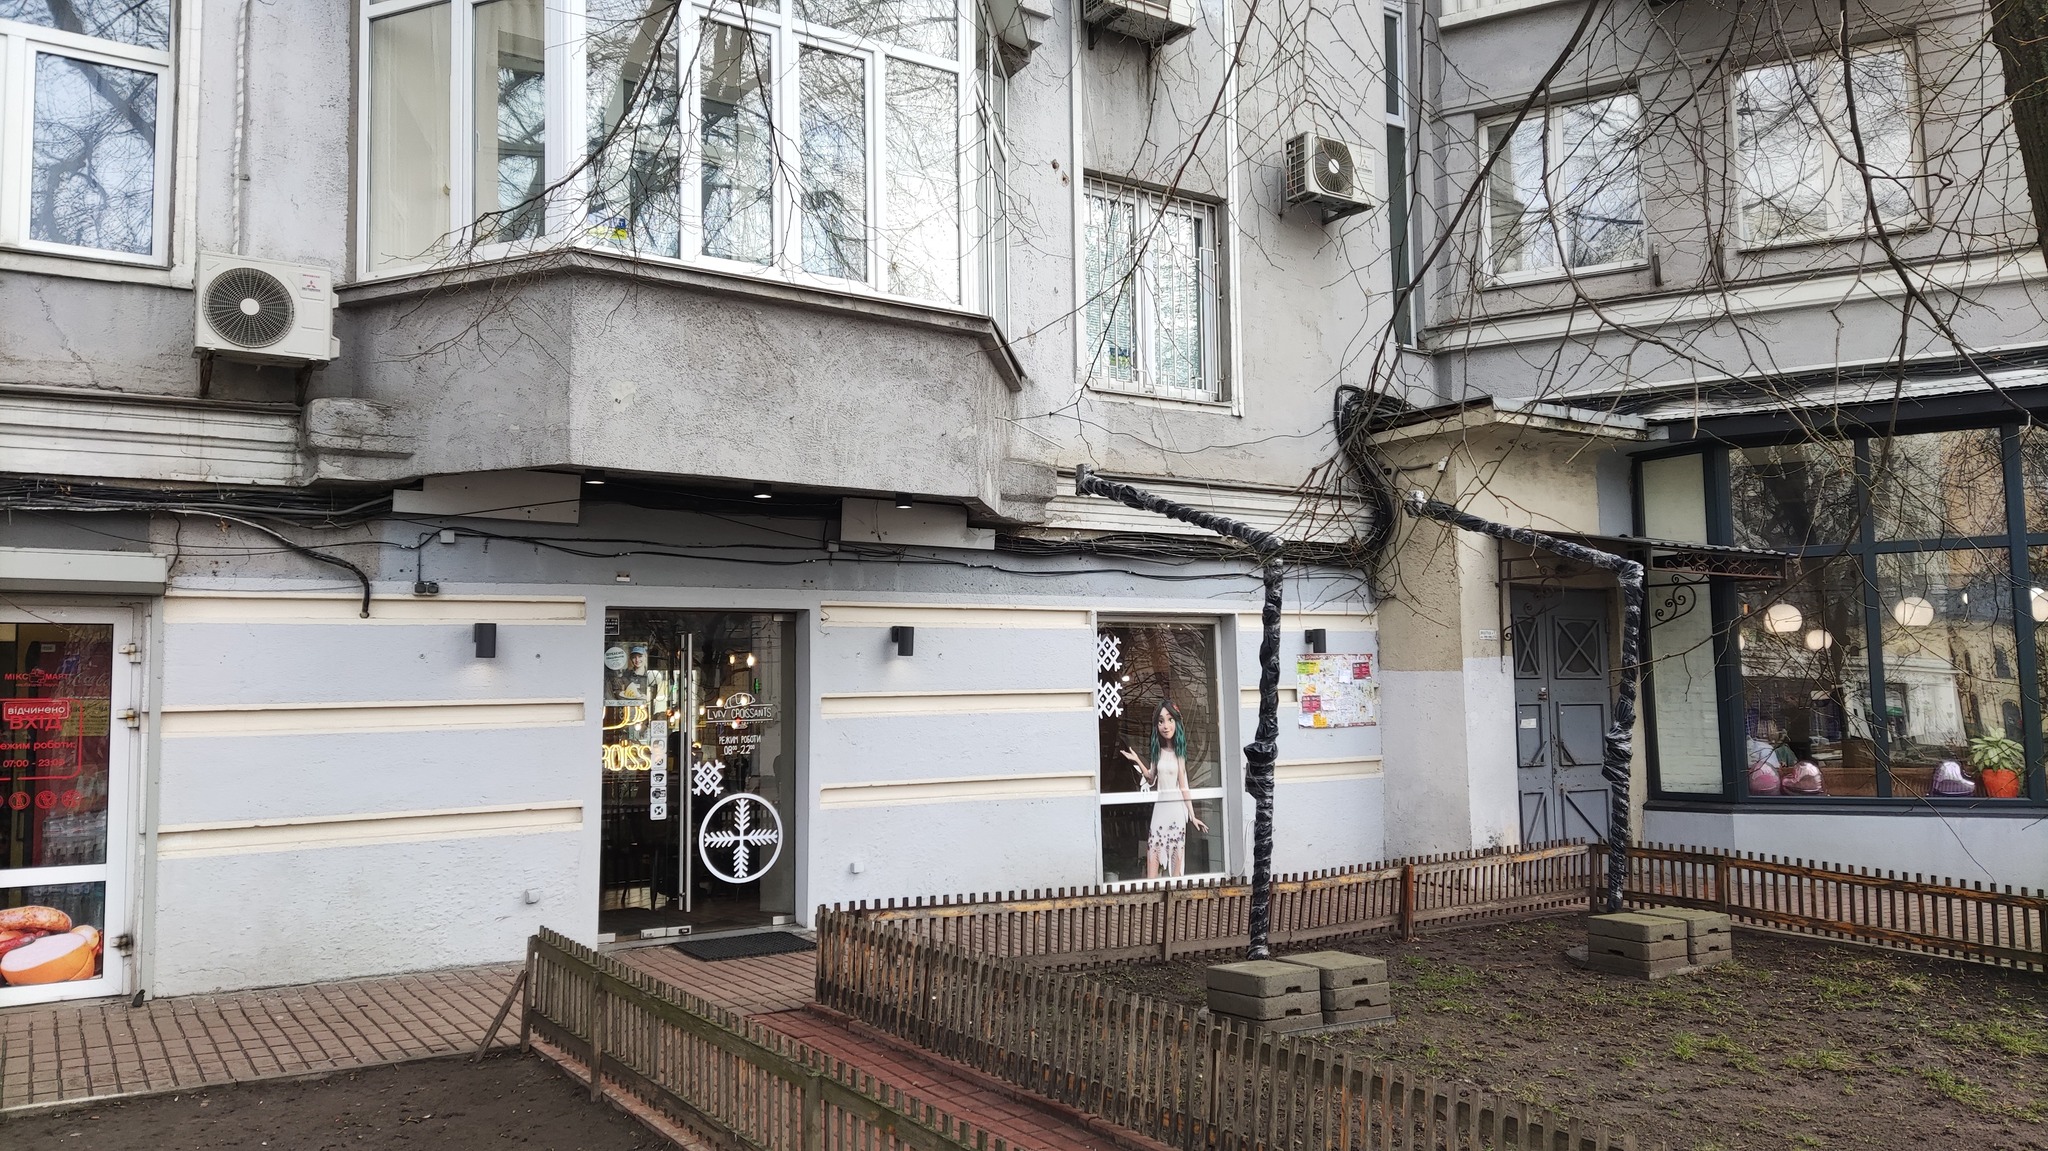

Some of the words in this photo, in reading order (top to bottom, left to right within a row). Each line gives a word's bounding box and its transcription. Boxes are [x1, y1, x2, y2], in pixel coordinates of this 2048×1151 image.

[7, 705, 66, 715] відчинено
[9, 715, 63, 731] ВХІД
[719, 736, 739, 745] РЕЖИМ
[741, 734, 762, 744] РОБОТИ
[0, 742, 31, 750] ежим
[3, 759, 29, 767] 07:00
